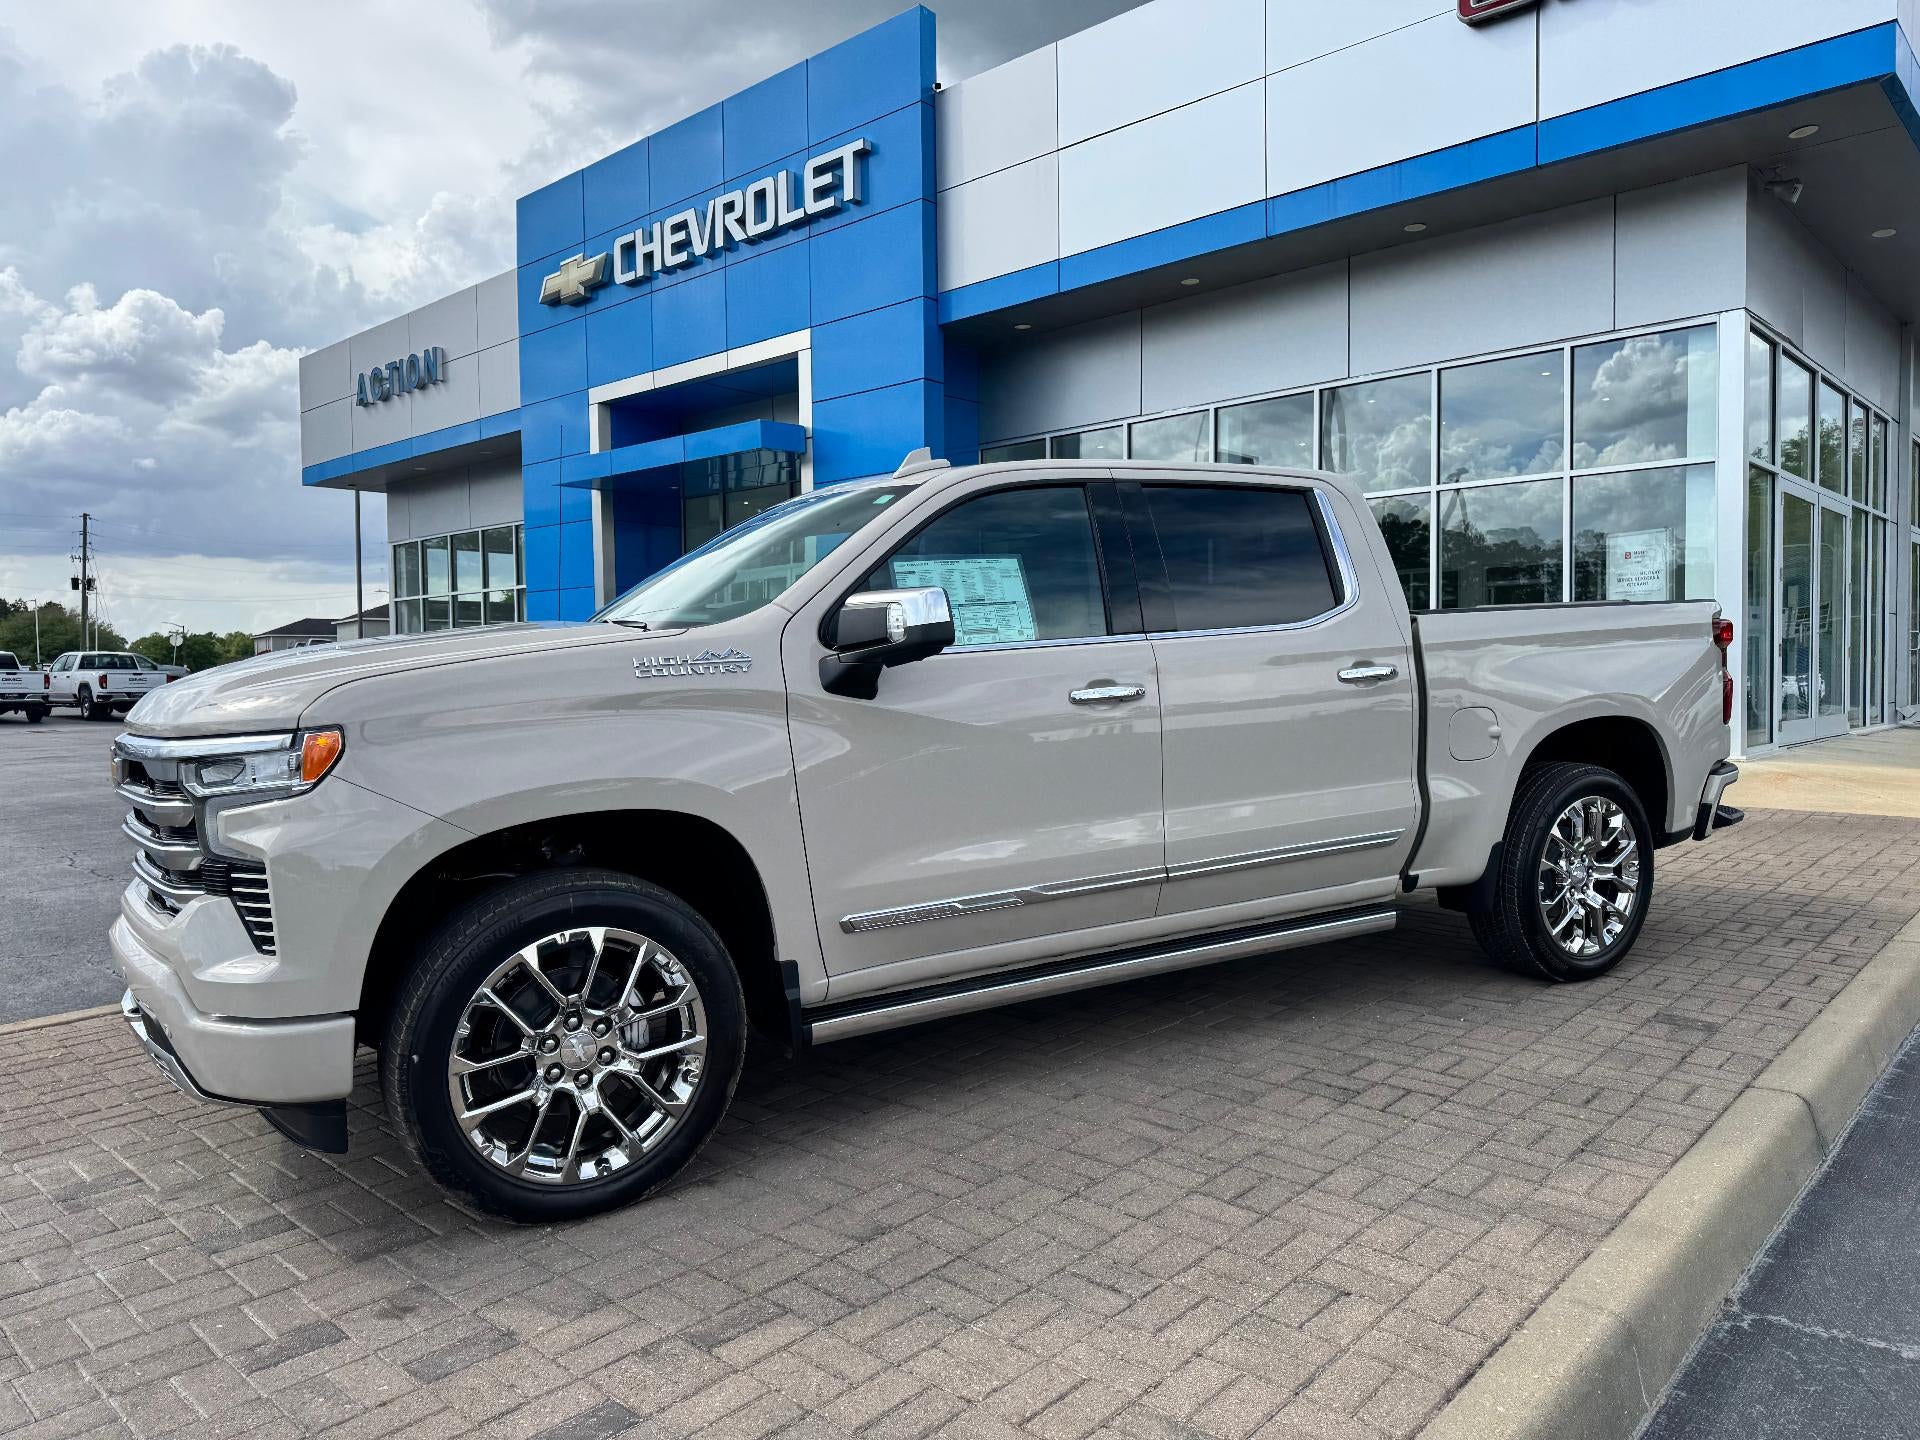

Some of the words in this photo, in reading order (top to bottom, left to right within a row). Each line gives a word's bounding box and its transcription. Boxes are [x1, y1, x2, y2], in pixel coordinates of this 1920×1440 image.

[613, 138, 872, 286] CHEVROLET
[356, 346, 443, 406] ACTION
[632, 654, 691, 668] HIGH
[634, 662, 752, 678] COUNTRY
